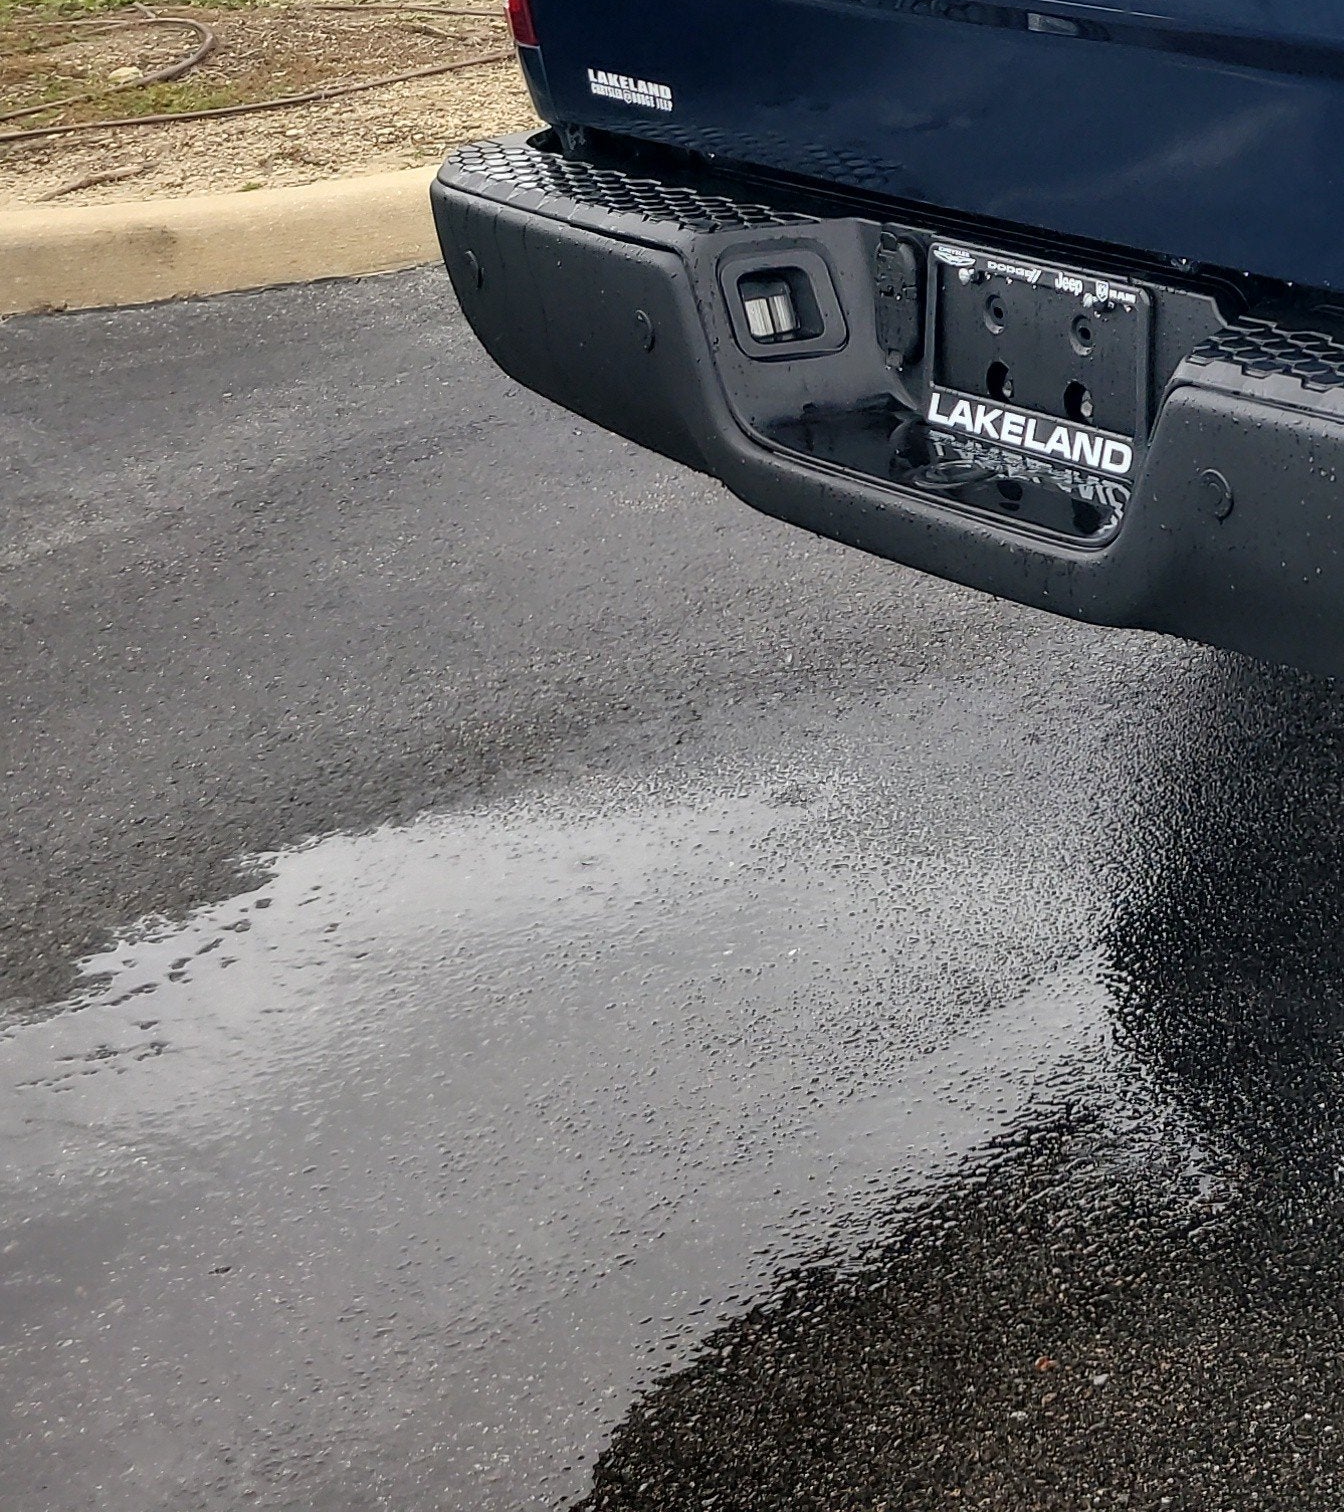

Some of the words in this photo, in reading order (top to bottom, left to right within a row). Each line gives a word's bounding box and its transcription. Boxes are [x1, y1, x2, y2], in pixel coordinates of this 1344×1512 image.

[587, 68, 673, 100] LAKELAND
[987, 260, 1036, 280] DODGE
[1054, 271, 1083, 296] Jeep
[1109, 289, 1137, 304] RAM
[927, 392, 1133, 474] LAKELAND
